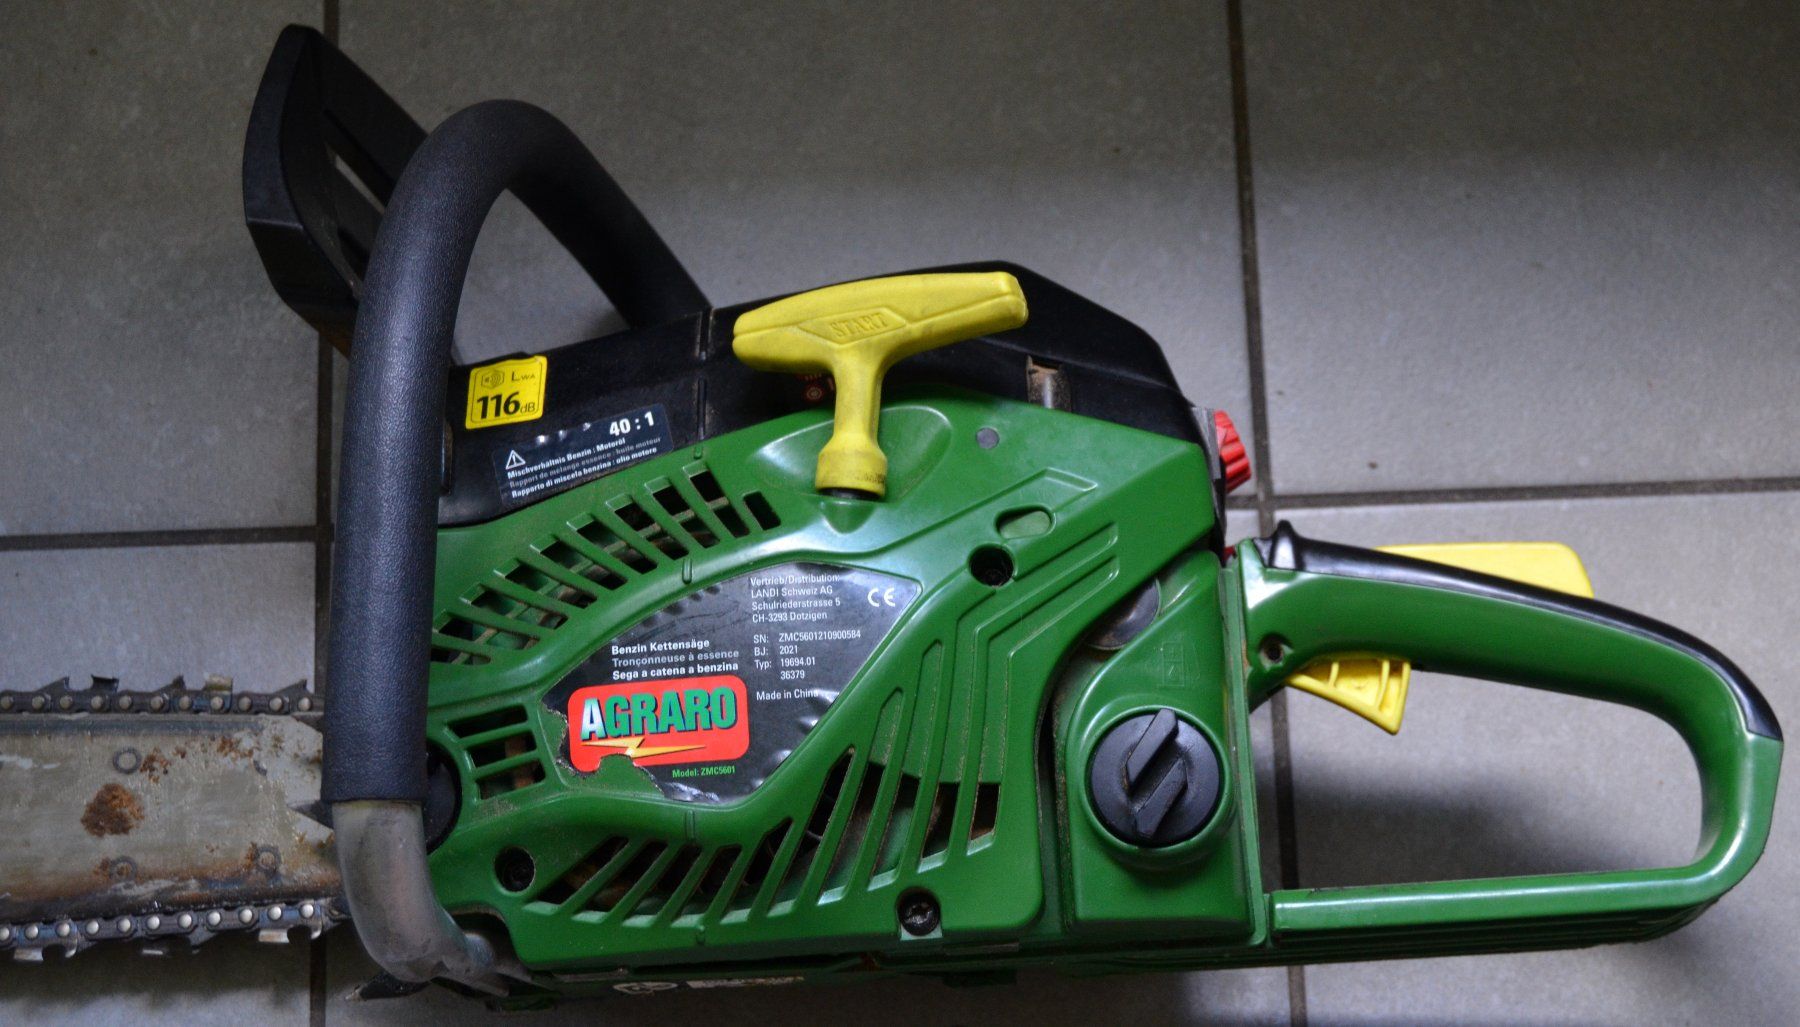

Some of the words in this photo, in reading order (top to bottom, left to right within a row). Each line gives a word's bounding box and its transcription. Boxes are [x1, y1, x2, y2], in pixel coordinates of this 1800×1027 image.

[831, 312, 888, 337] START
[609, 417, 631, 437] 40
[644, 411, 654, 427] 1
[566, 448, 592, 461] Benzin
[509, 474, 539, 489] Rapport
[539, 471, 548, 480] de
[635, 437, 661, 449] moteur
[511, 482, 545, 499] Rapporto
[545, 478, 553, 487] di
[554, 470, 583, 484] miscela
[583, 460, 612, 475] benzina
[616, 454, 631, 465] olio
[631, 447, 658, 460] motore
[751, 587, 779, 598] LANDI
[781, 586, 818, 597] Schweiz
[820, 585, 833, 595] AG
[752, 598, 833, 612] Schulriederstrasse
[835, 597, 841, 607] 5
[752, 611, 788, 623] CH-3293
[790, 611, 828, 622] Dotzigen
[753, 634, 769, 644] SN:
[611, 643, 647, 656] Benzin
[650, 638, 710, 653] Kettensäge
[754, 646, 769, 657] BJ:
[779, 645, 799, 655] 2021
[612, 654, 686, 668] Tronçonneuse
[688, 651, 694, 661] à
[697, 650, 740, 661] essence
[754, 659, 772, 671] Typ:
[780, 656, 816, 668] 19694.01
[612, 670, 639, 681] Sega
[641, 669, 648, 678] a
[650, 666, 686, 678] catena
[688, 666, 695, 674] a
[696, 661, 739, 673] benzina
[780, 669, 806, 680] 36379
[756, 690, 782, 701] Made
[784, 690, 792, 699] in
[794, 688, 819, 699] China
[580, 686, 738, 741] AGRARO
[672, 767, 700, 779] Model:
[700, 765, 736, 777] ZMC5601
